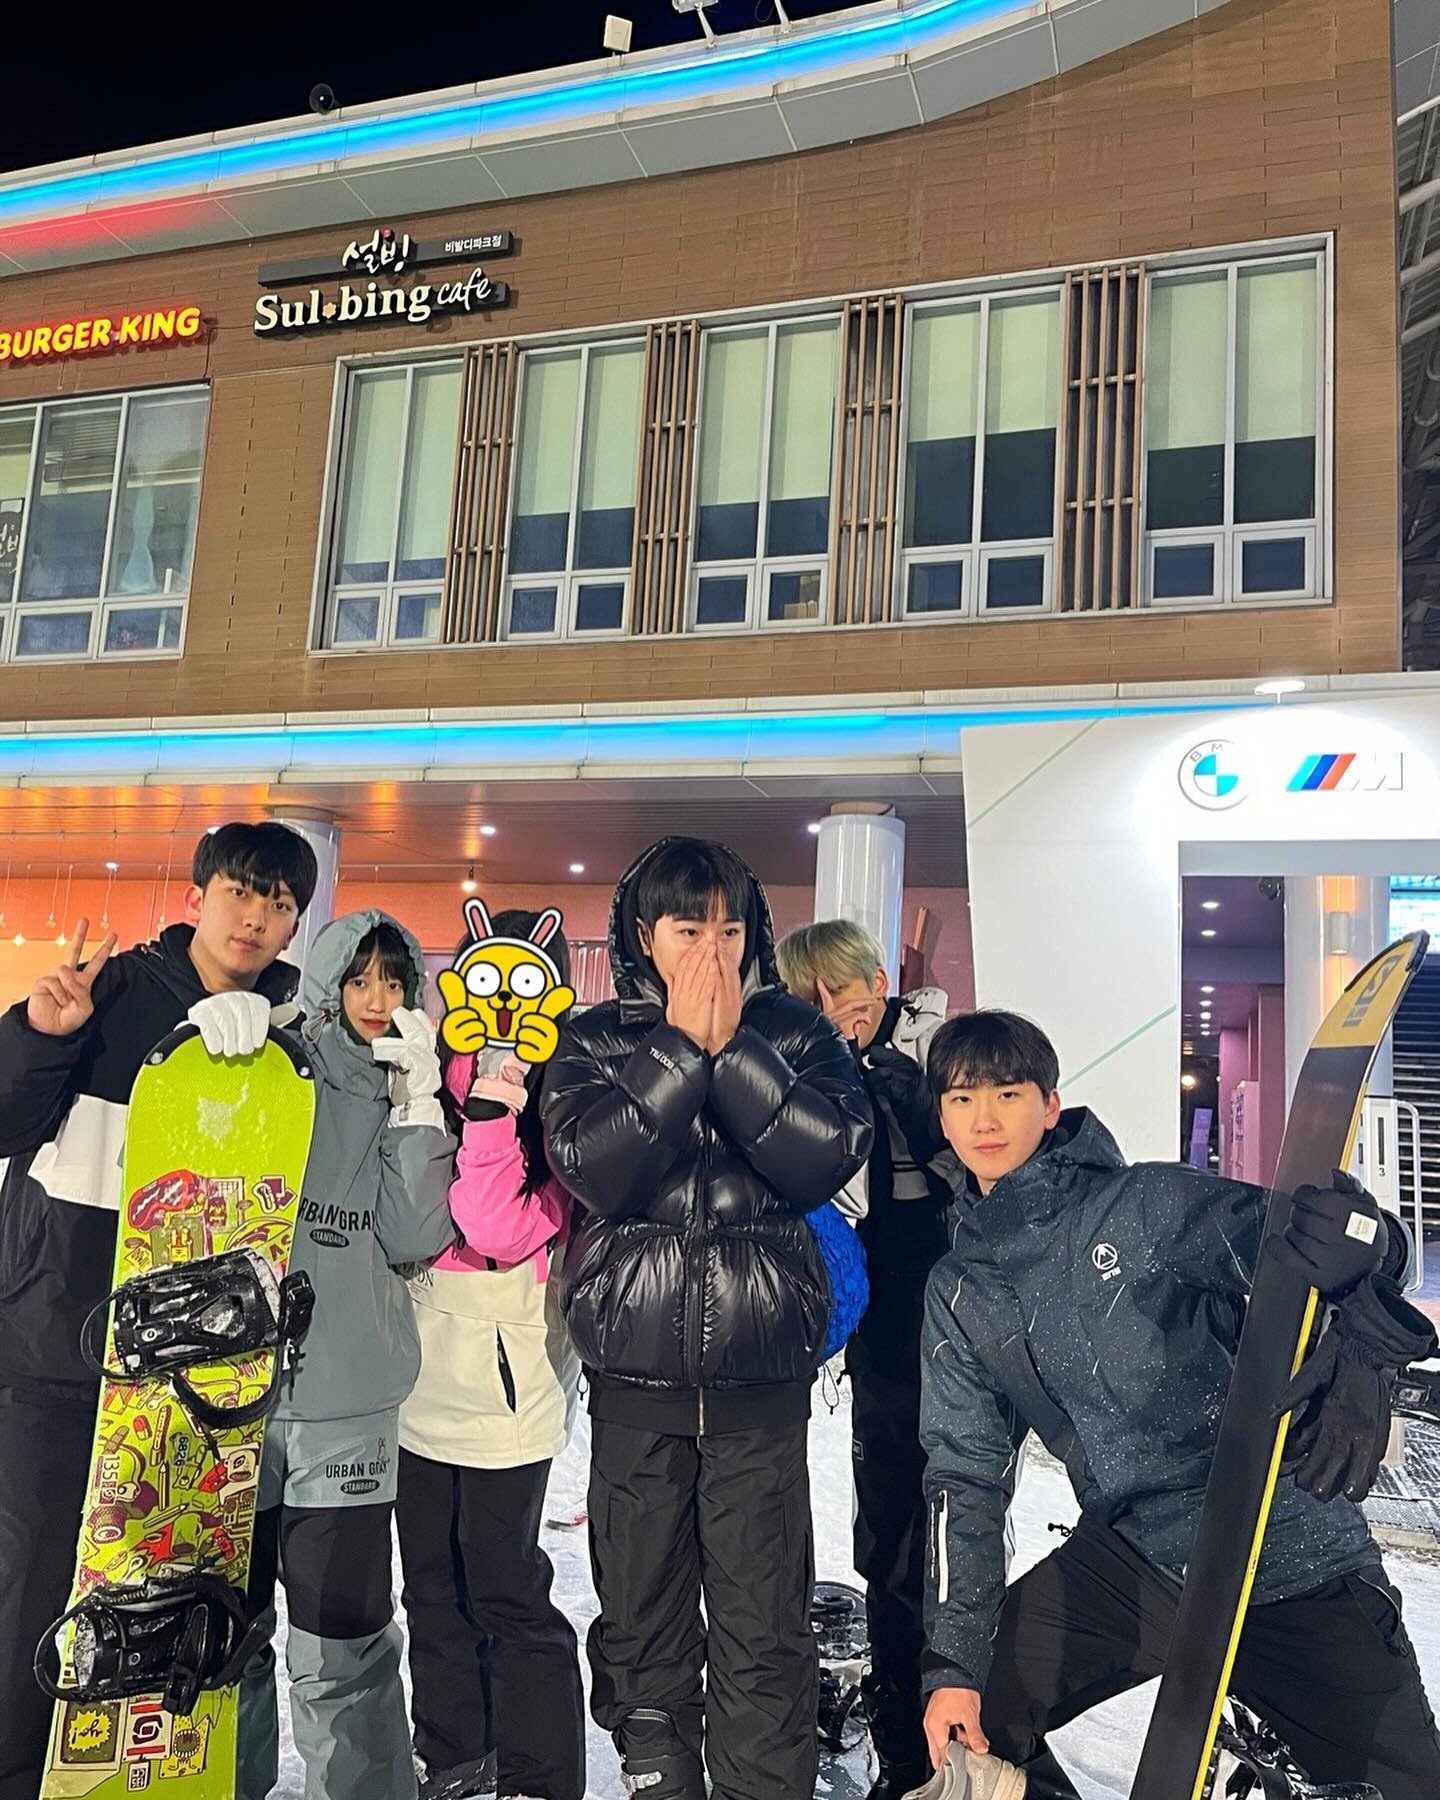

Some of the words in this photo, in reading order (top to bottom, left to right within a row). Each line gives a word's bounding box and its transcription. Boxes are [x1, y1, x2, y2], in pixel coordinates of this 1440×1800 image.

[444, 234, 503, 253] 비발디파크점
[436, 267, 492, 311] cafe
[0, 318, 112, 361] BURGER
[119, 307, 201, 344] KING
[311, 1230, 347, 1246] STANDARD
[102, 1455, 120, 1481] 135
[325, 1462, 365, 1478] URBAN
[343, 1482, 378, 1493] STANDARD
